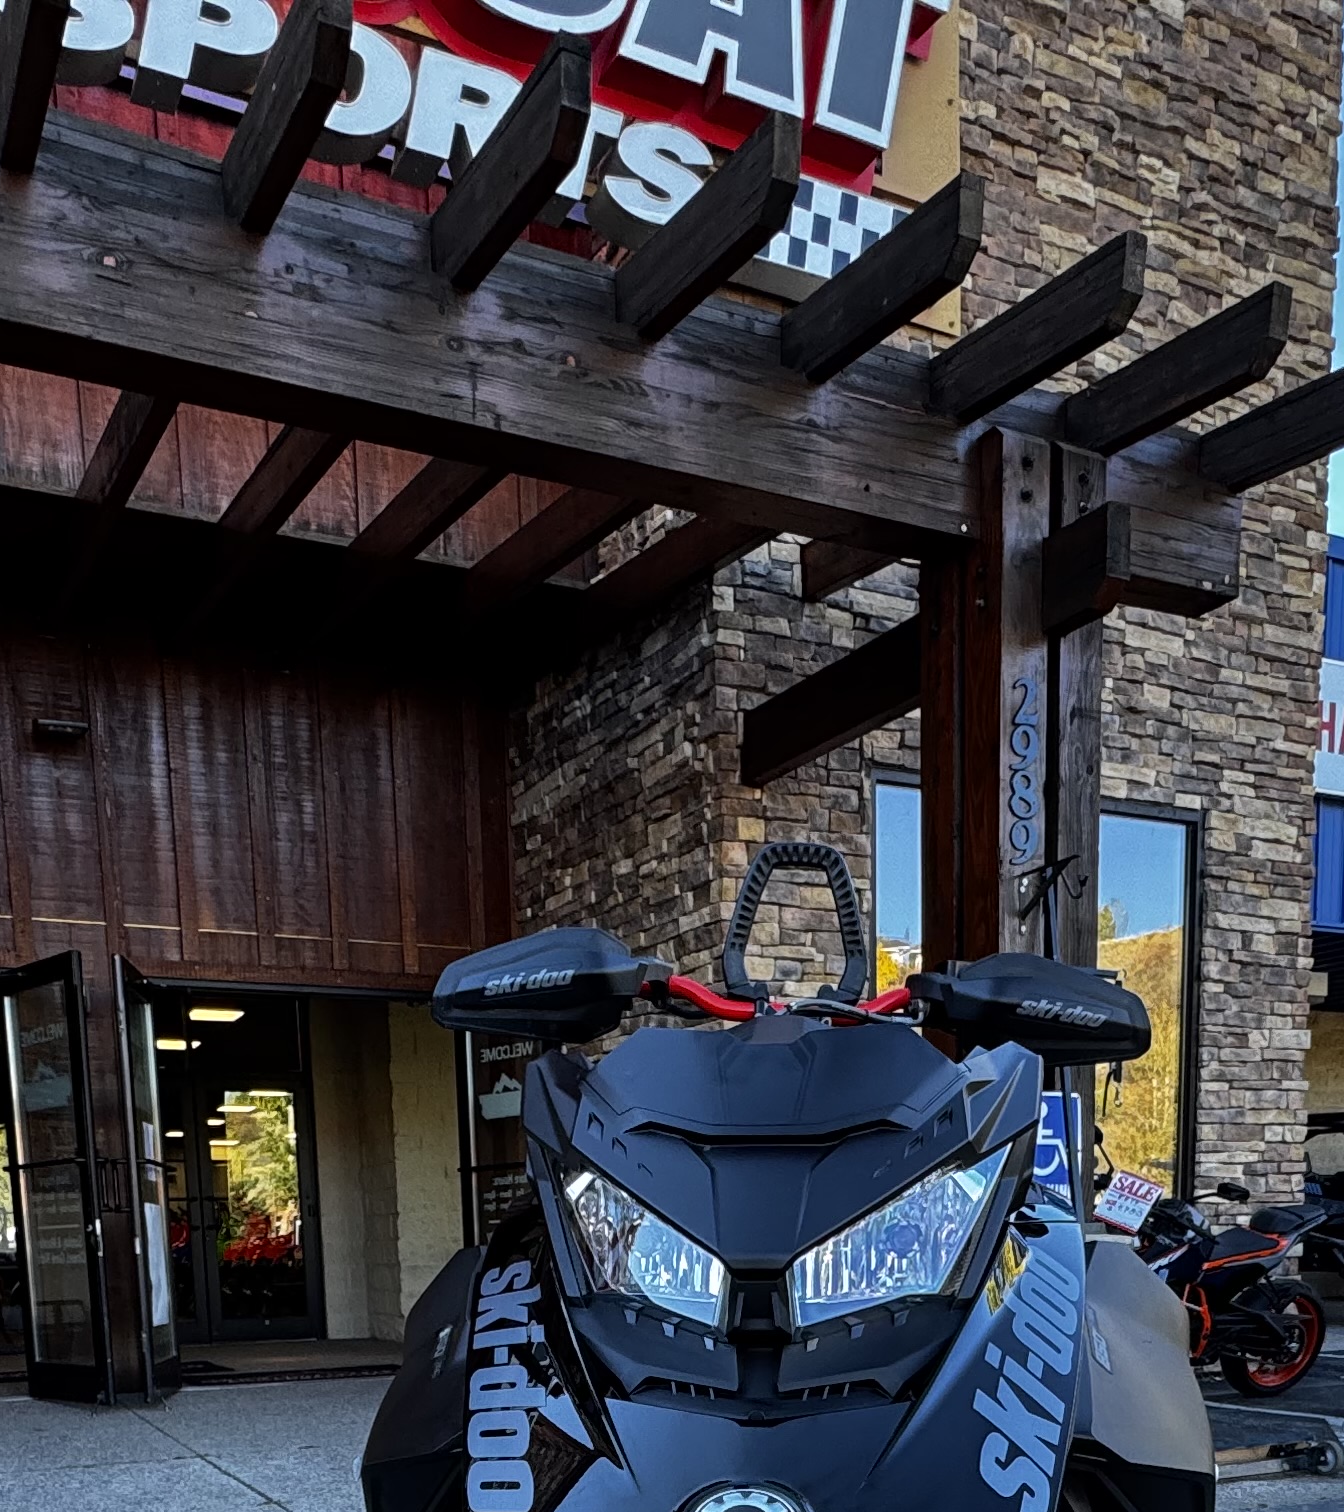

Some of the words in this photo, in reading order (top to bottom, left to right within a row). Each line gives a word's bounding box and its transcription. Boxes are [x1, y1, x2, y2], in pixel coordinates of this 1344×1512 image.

[1008, 677, 1041, 866] 2989
[484, 968, 575, 996] ski-doo
[1016, 999, 1108, 1028] ski-doo
[1112, 1174, 1157, 1203] SALE
